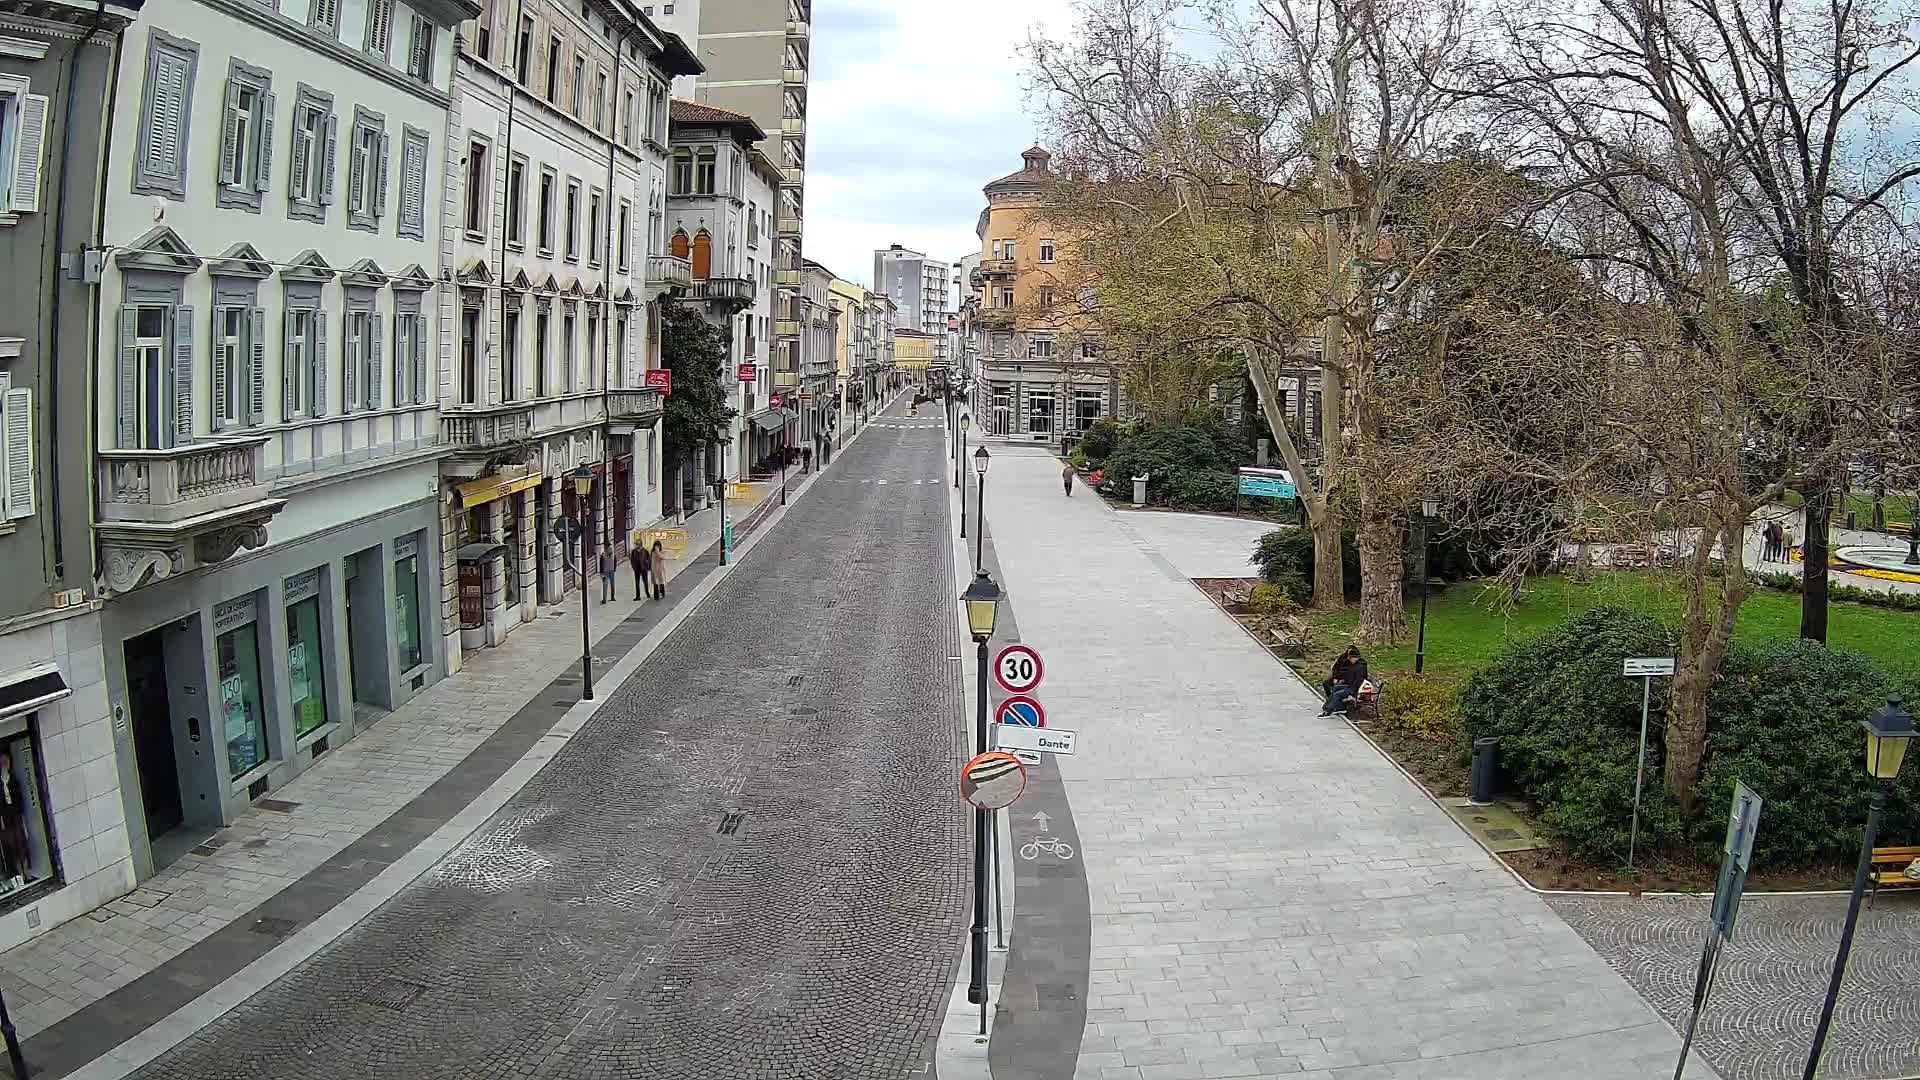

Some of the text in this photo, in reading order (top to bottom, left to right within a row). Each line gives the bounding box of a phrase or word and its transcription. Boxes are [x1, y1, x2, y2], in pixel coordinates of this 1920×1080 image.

[1005, 658, 1033, 680] 30
[221, 677, 241, 701] 130
[1038, 738, 1070, 749] Dante
